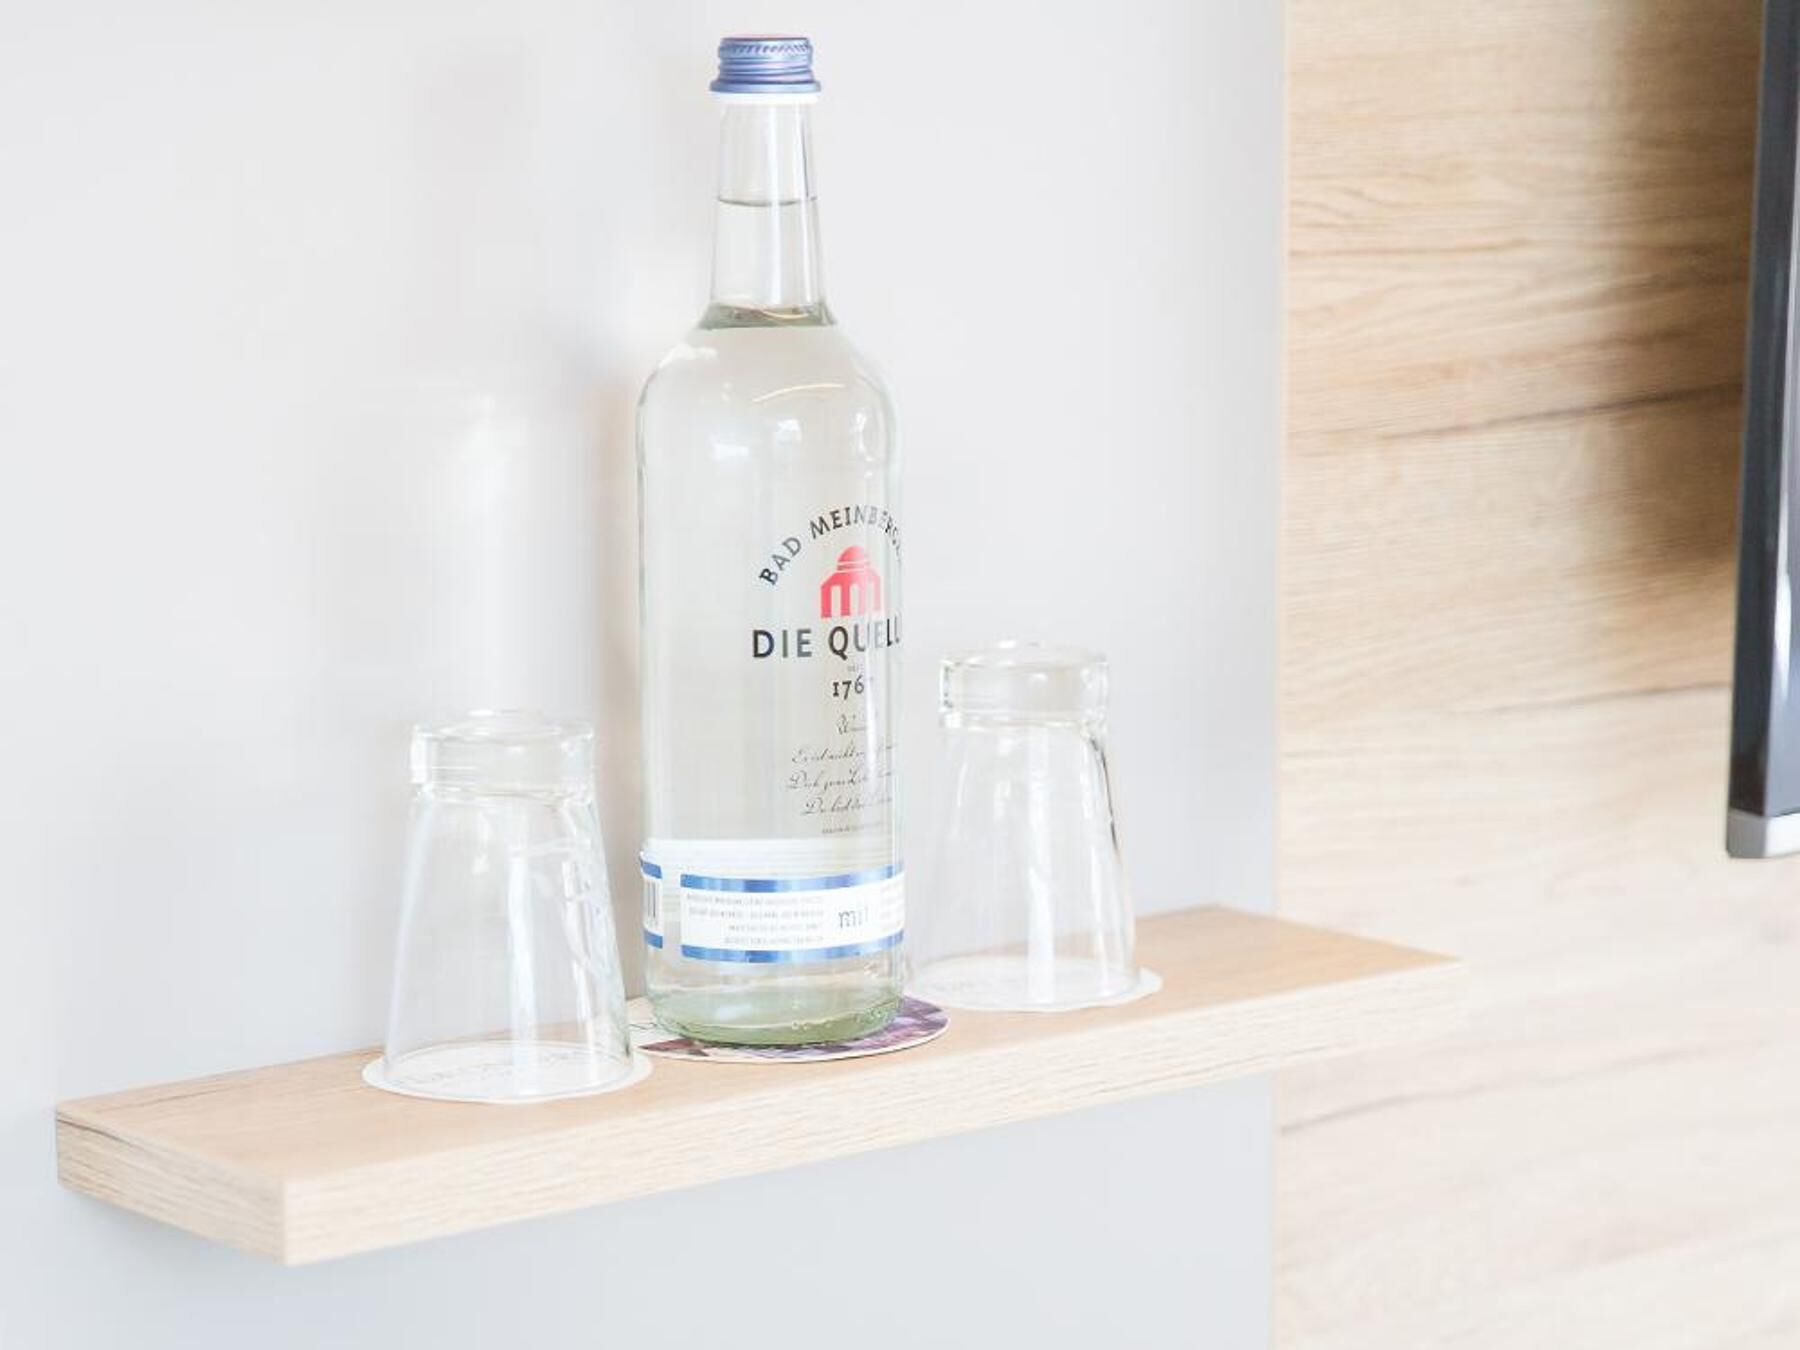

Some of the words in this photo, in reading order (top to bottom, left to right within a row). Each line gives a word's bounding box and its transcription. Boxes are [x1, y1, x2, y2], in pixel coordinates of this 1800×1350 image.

[758, 536, 802, 585] BAD
[752, 628, 812, 659] DIE
[832, 675, 874, 700] 176
